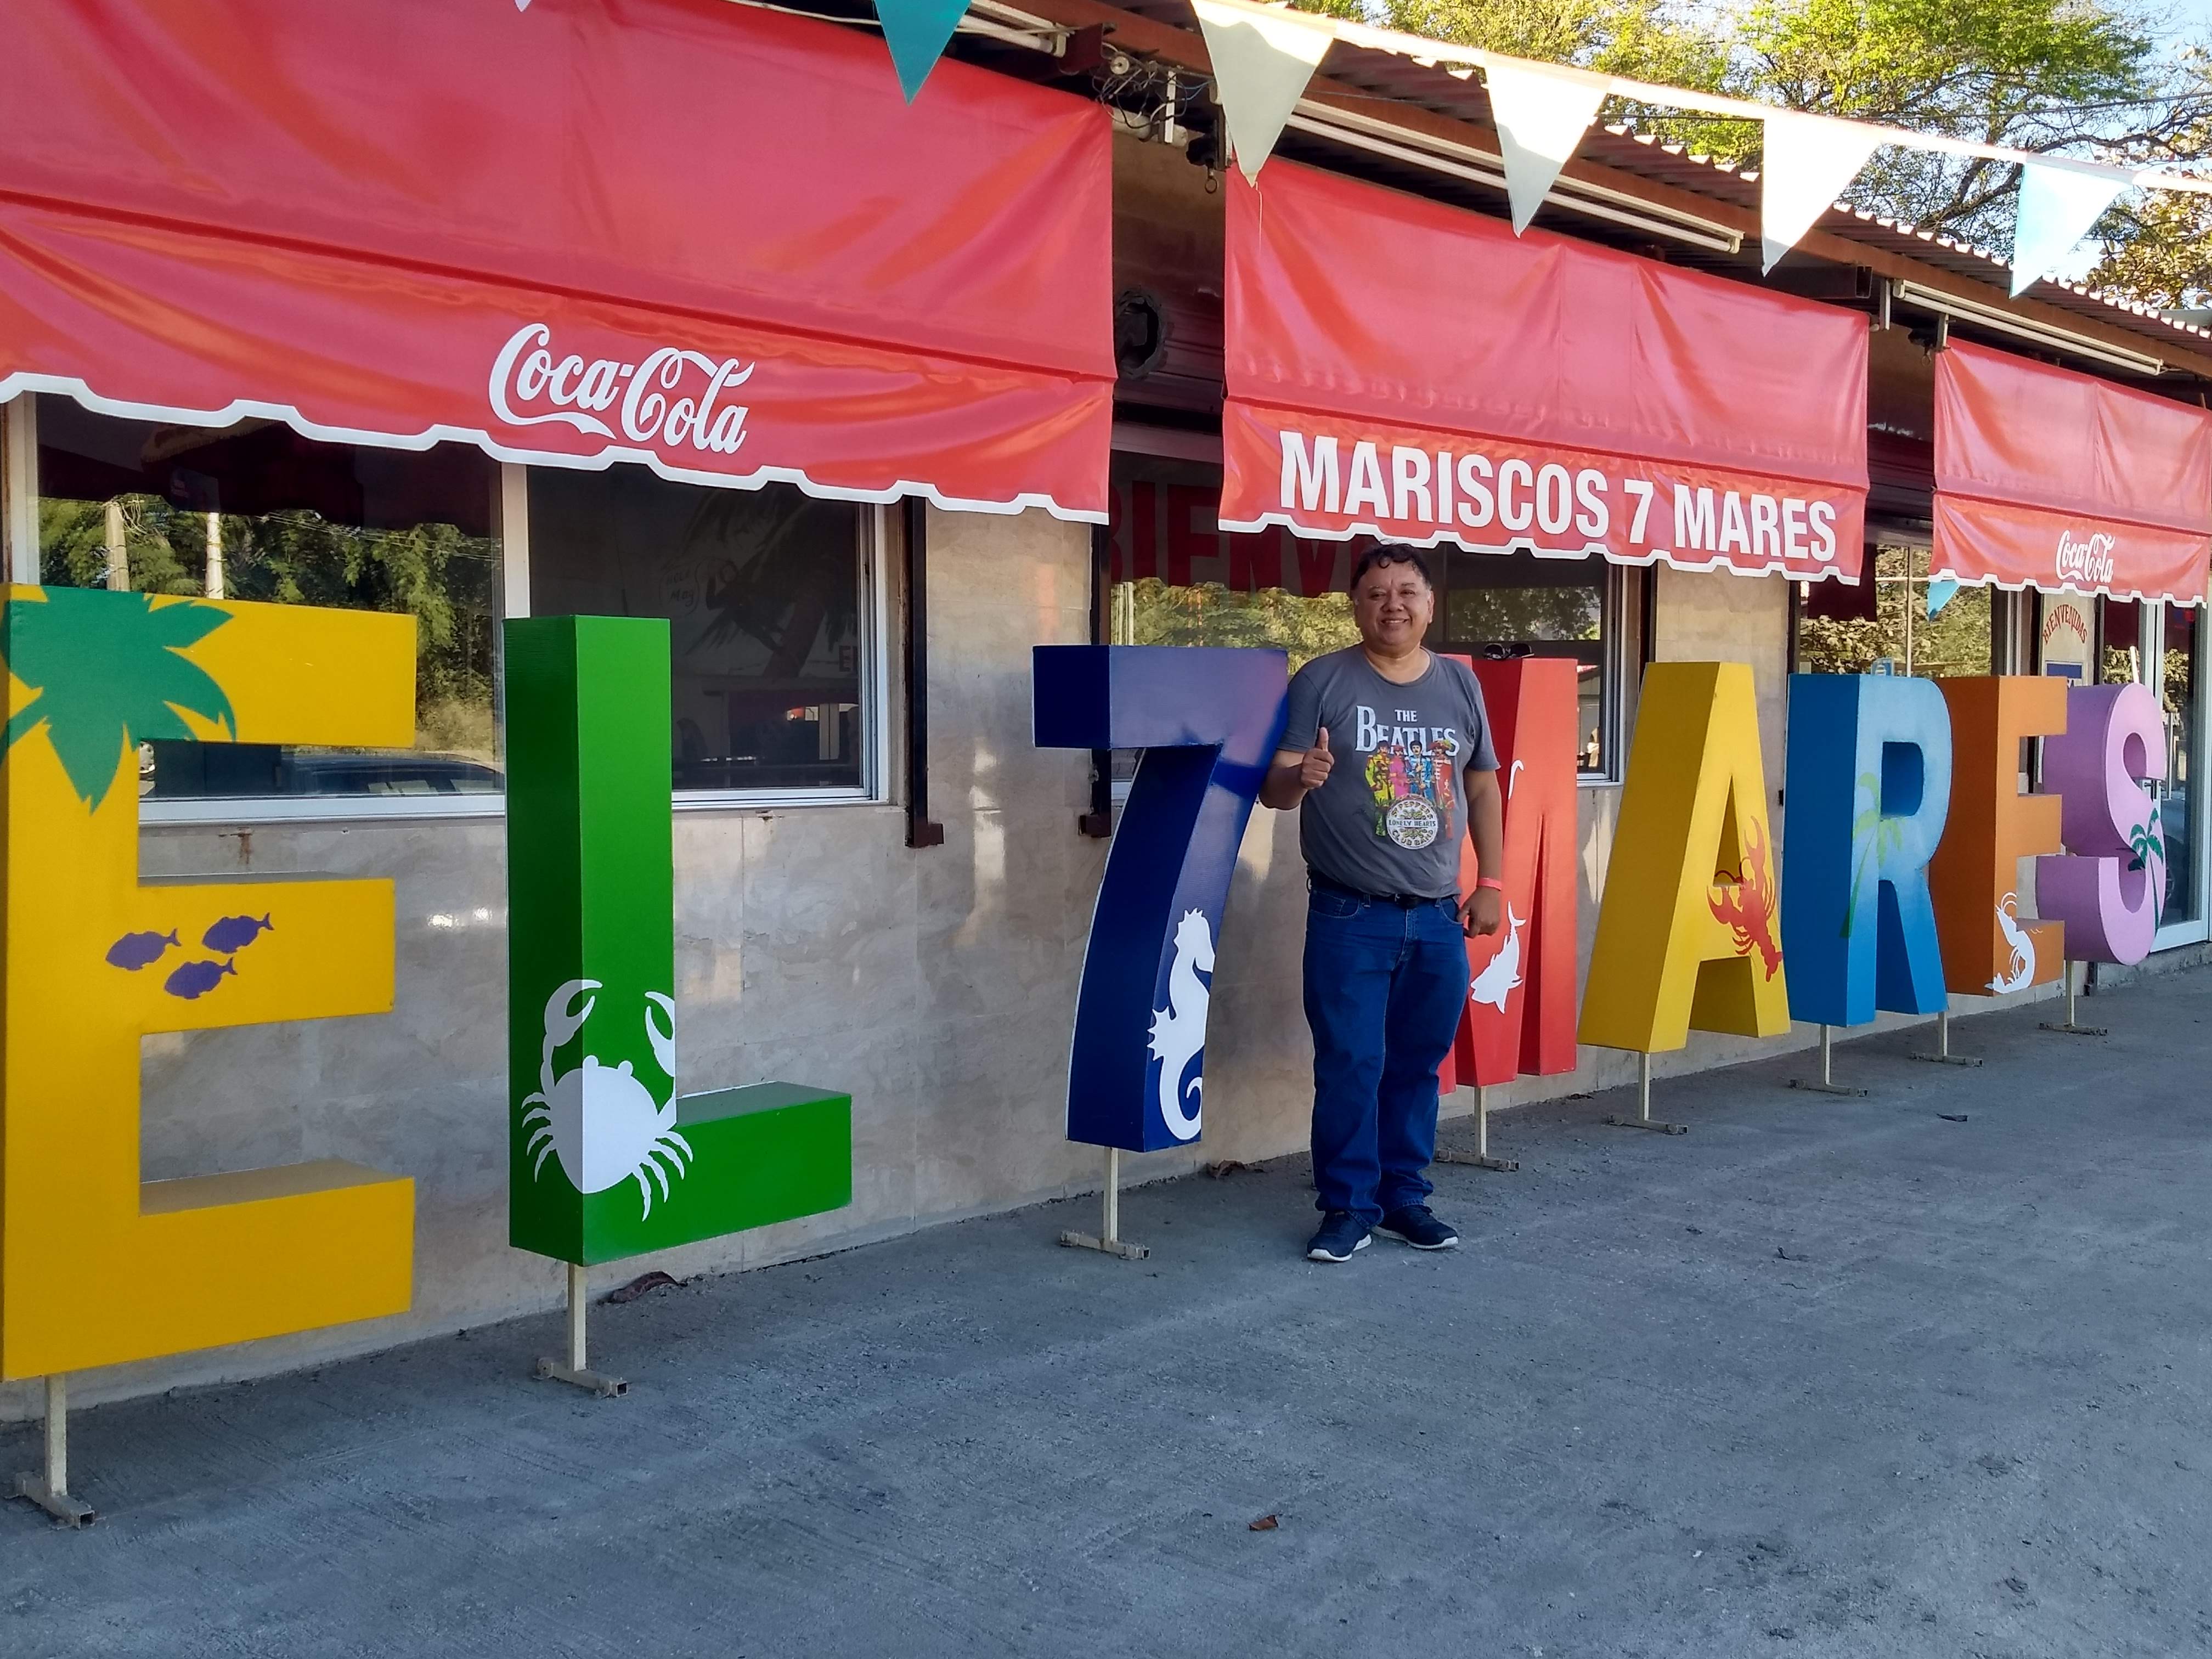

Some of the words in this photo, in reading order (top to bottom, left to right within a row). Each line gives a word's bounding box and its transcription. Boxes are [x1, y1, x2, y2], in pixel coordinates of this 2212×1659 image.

[489, 323, 755, 454] Coca-Cola
[1279, 431, 1610, 539] MARISCOS
[1624, 479, 1655, 544] 7
[1674, 483, 1836, 562] MARES
[2056, 530, 2115, 583] Coca-Cola
[1356, 706, 1460, 757] BEATLES
[1395, 709, 1418, 723] THE
[1032, 644, 1288, 1152] 7
